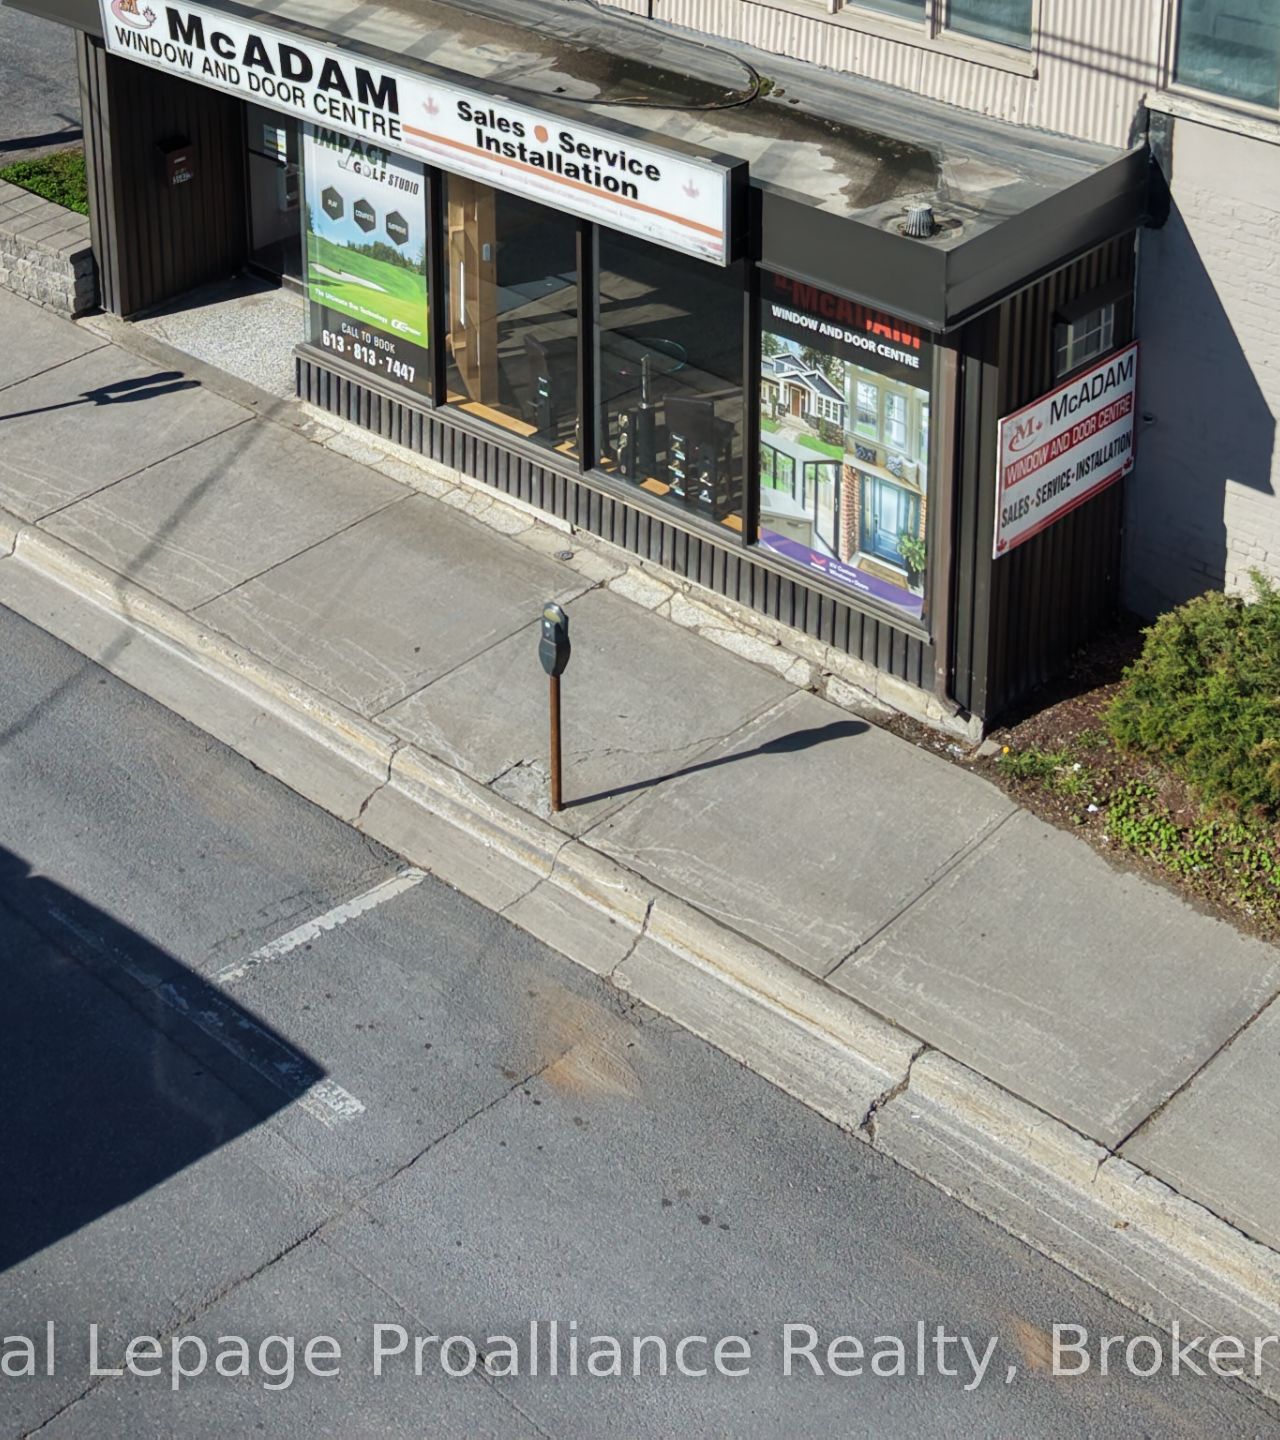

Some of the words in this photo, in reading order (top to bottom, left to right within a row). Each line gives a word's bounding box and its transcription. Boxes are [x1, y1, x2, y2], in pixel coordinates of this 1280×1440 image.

[115, 25, 194, 69] WINDOW
[202, 56, 241, 86] AND
[248, 72, 306, 109] DOOR
[313, 93, 403, 143] CENTRE
[165, 6, 400, 116] McADAM
[313, 125, 391, 168] IMPACT
[456, 100, 526, 138] Sales
[558, 131, 662, 182] Service
[476, 128, 639, 200] Installation
[388, 173, 419, 195] STUDIO
[322, 329, 345, 352] 613
[353, 343, 376, 366] 813
[385, 356, 416, 383] 7447
[341, 322, 360, 339] CALL
[361, 330, 372, 344] TO
[374, 336, 396, 354] BOOK
[772, 305, 819, 331] WINDOW
[819, 322, 843, 340] AND
[844, 331, 877, 353] DOOR
[877, 344, 920, 369] CENTRE
[1050, 354, 1134, 425] McADAM
[1007, 447, 1049, 485] WINDOW
[1051, 434, 1070, 459] AND
[1072, 419, 1097, 445] DOOR
[1098, 398, 1132, 429] CENTRE
[1001, 495, 1030, 529] SALES
[1036, 469, 1071, 506] SERVICE
[1076, 430, 1132, 482] INSTALLATION
